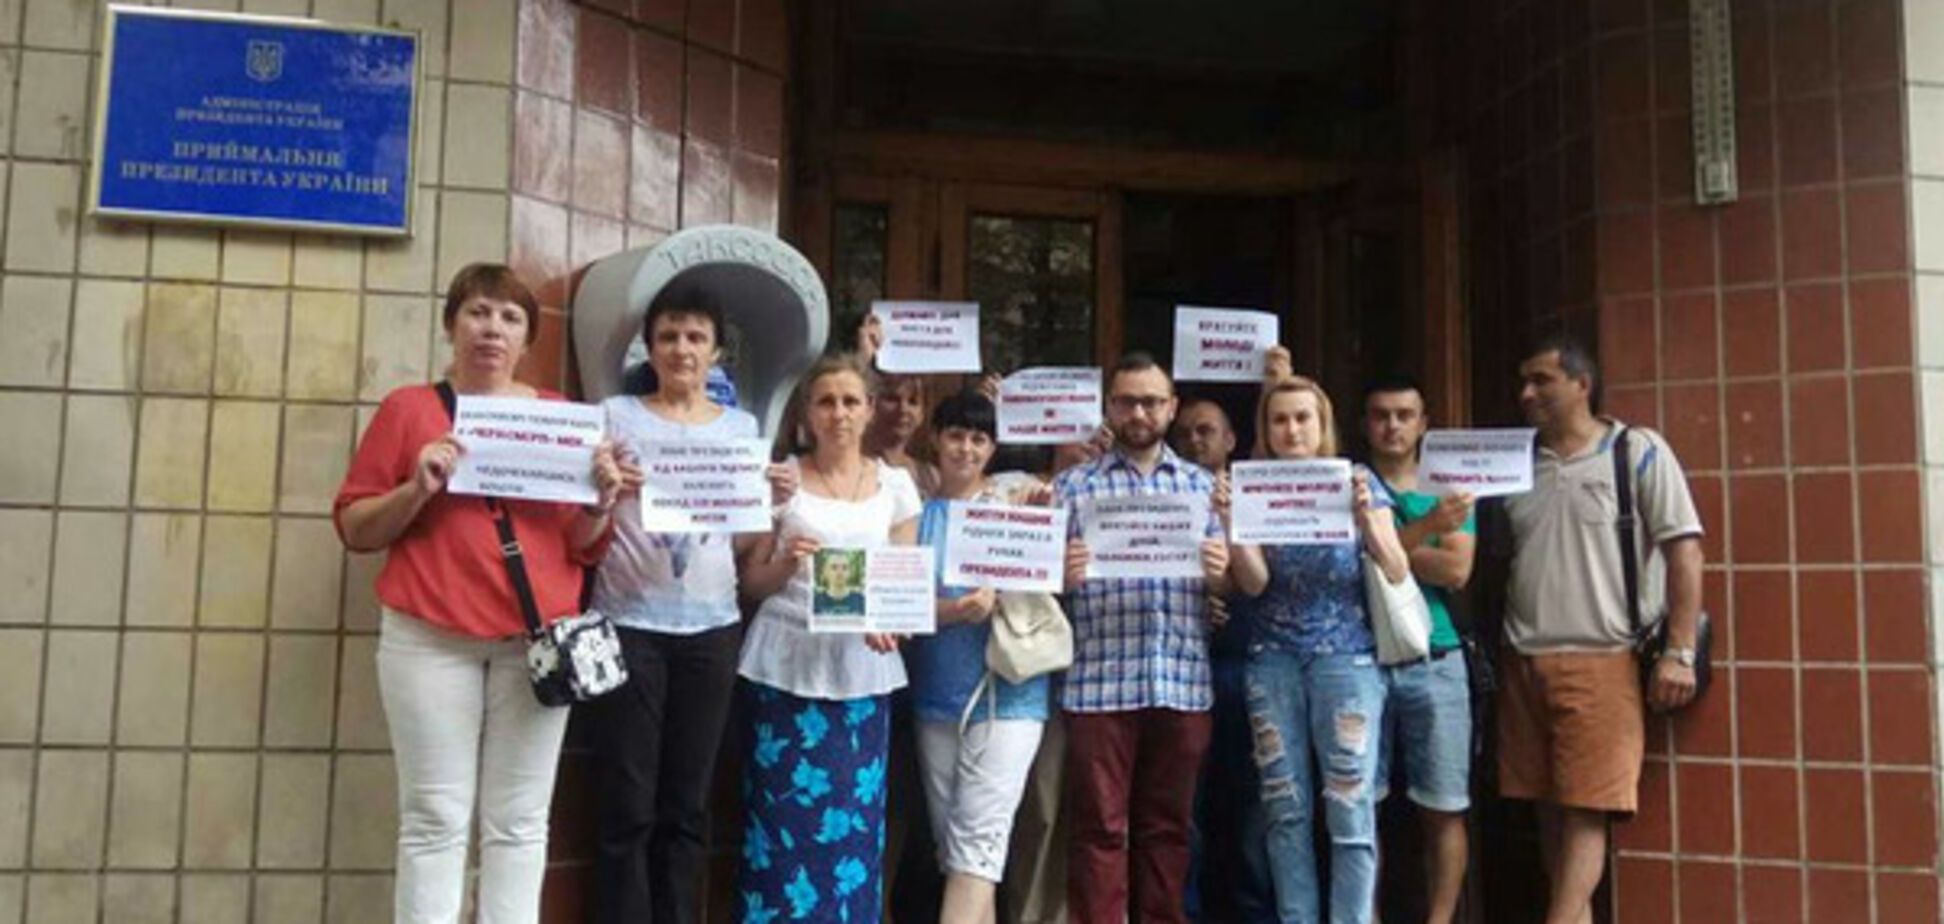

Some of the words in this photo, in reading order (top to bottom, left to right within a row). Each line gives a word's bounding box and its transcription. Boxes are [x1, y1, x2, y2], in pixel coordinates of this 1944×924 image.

[174, 107, 273, 125] ПРЕЗИДЕНТА
[276, 113, 344, 130] УКРАЇНИ
[173, 140, 344, 166] ПРИЙМАЛЬНЯ
[121, 161, 277, 186] ПРЕЗИДЕНТА
[279, 170, 389, 194] УКРАЇНИ
